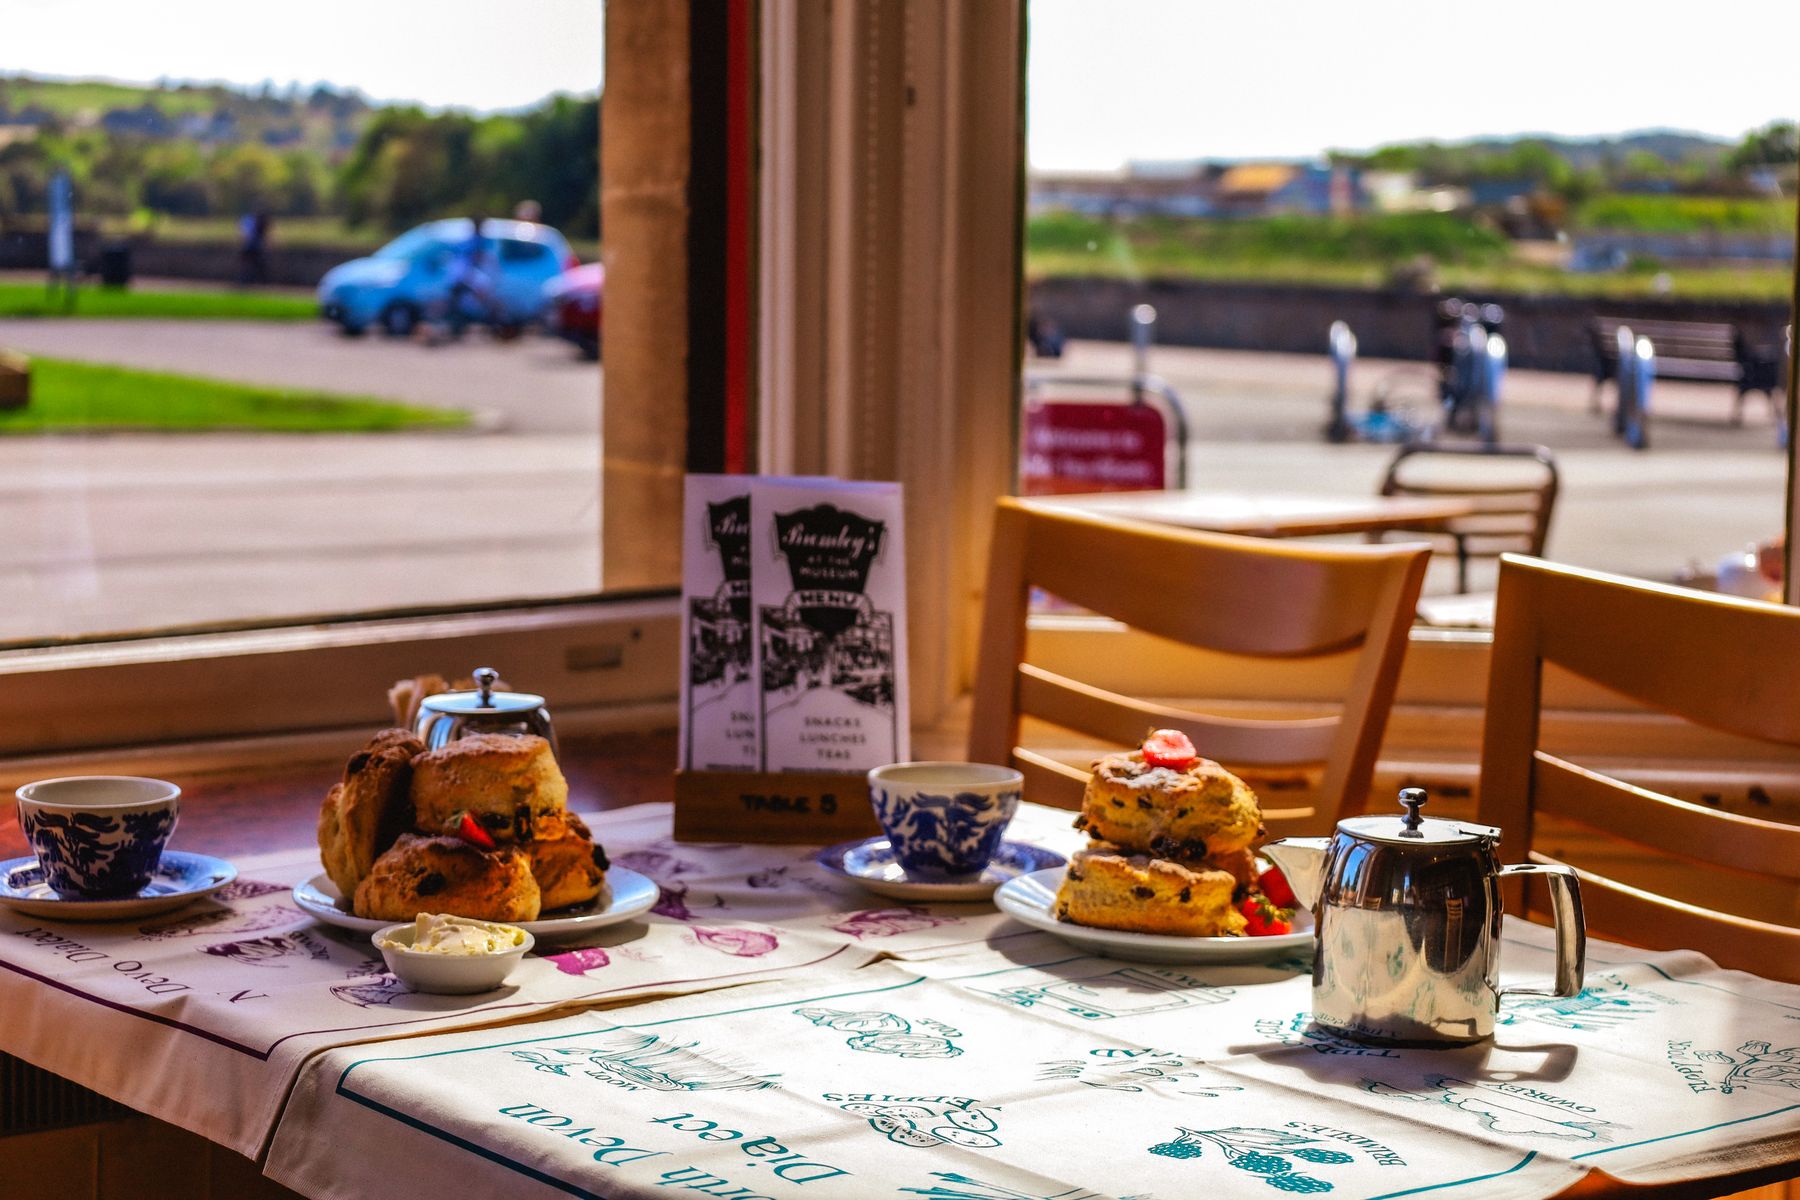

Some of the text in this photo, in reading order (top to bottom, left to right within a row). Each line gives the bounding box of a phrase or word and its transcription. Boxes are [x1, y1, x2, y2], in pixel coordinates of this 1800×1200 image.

[801, 591, 858, 606] MENU
[804, 716, 861, 728] SNACKS
[800, 733, 867, 744] LUNCHES
[817, 748, 851, 760] TEAS
[740, 793, 811, 814] TABLE
[499, 1102, 674, 1168] Devon
[1284, 1122, 1407, 1168] BRIMBLES
